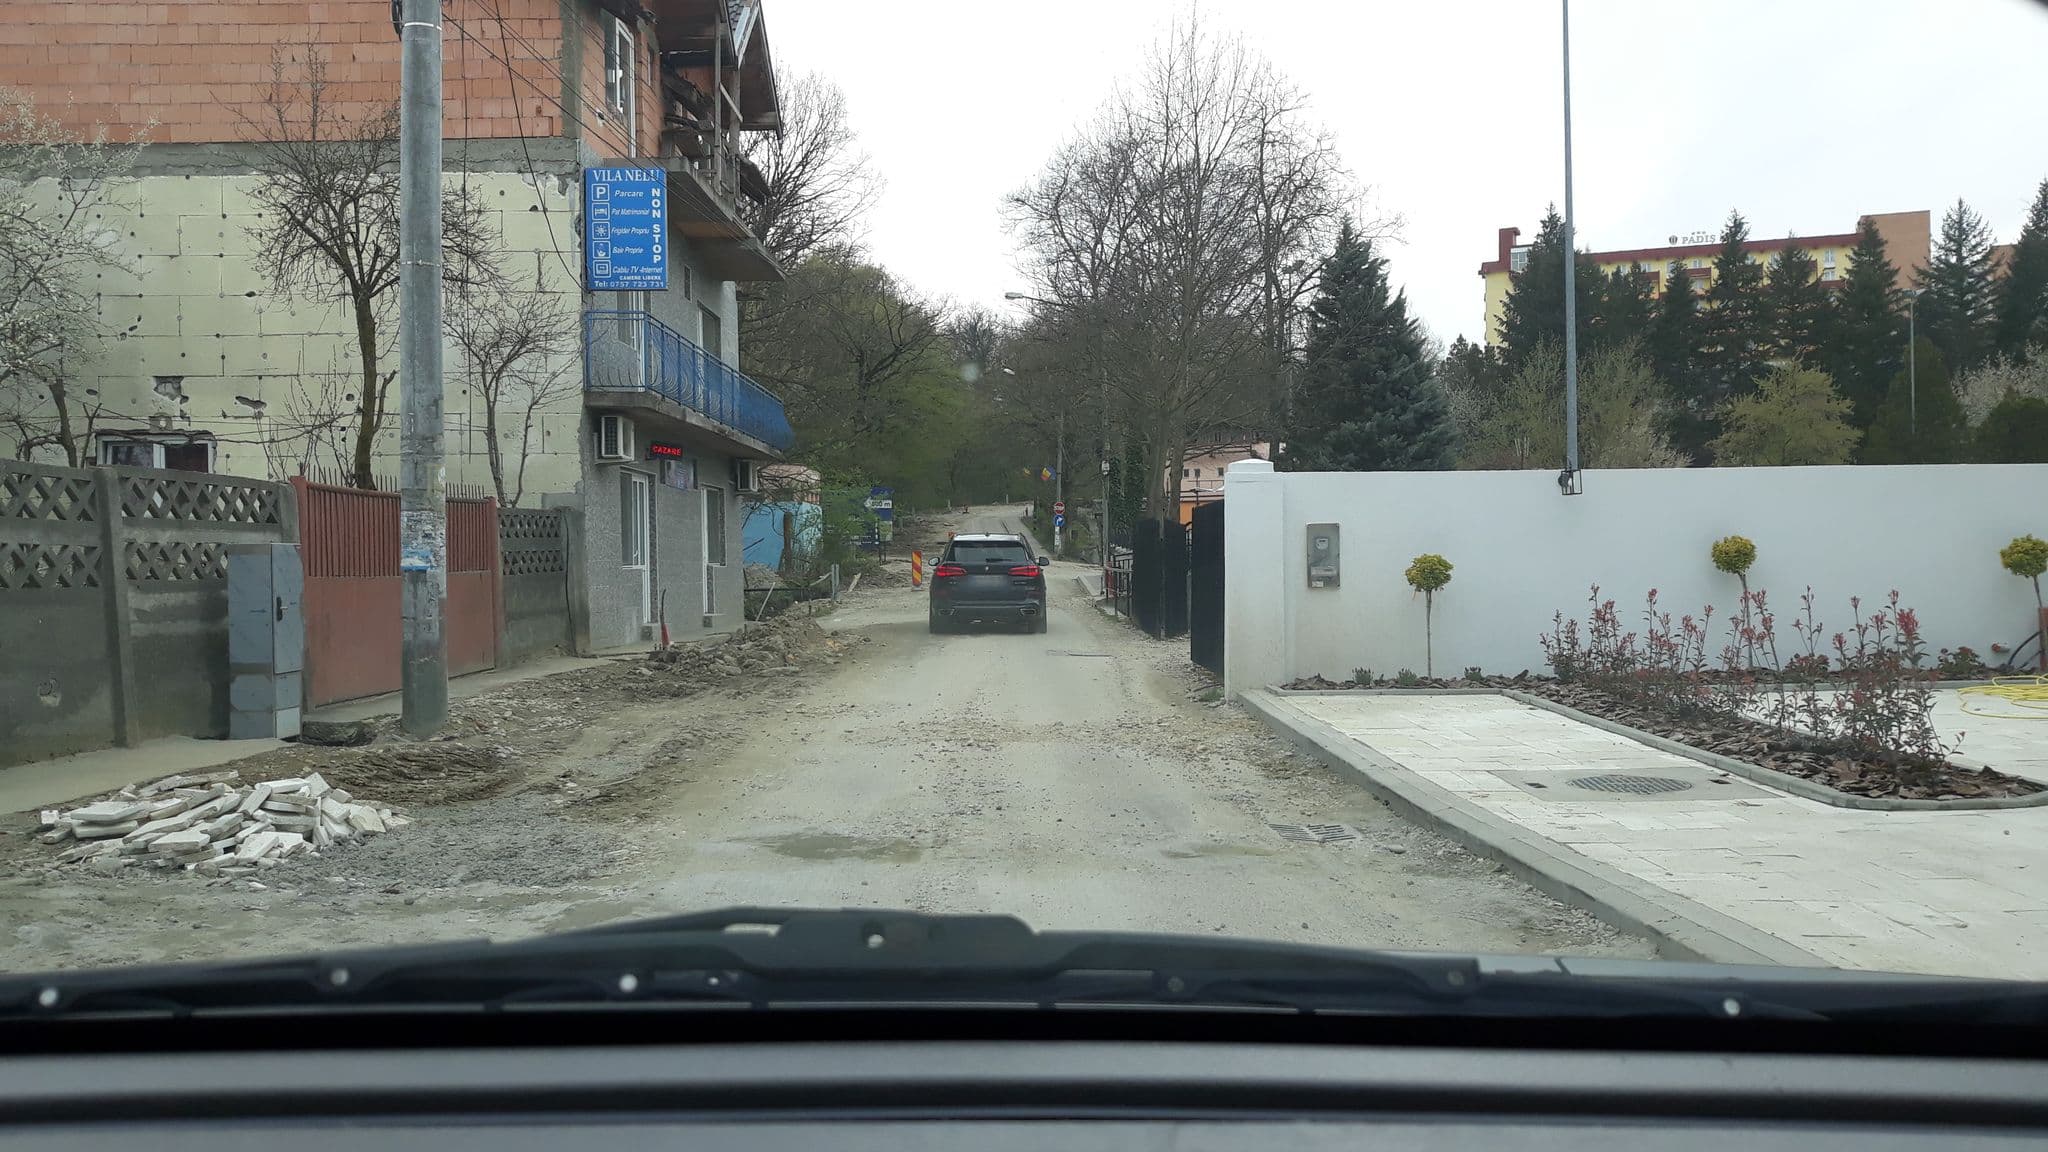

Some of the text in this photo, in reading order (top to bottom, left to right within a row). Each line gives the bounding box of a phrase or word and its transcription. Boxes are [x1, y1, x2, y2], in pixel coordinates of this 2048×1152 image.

[593, 169, 659, 182] VILA NELU
[597, 186, 606, 199] P
[614, 189, 644, 198] Parcare
[651, 188, 662, 264] NON STOP
[624, 246, 644, 255] Proprie
[612, 266, 630, 274] Cablu
[630, 266, 639, 274] TV
[594, 280, 608, 288] Tel:
[652, 445, 682, 456] CAZARE
